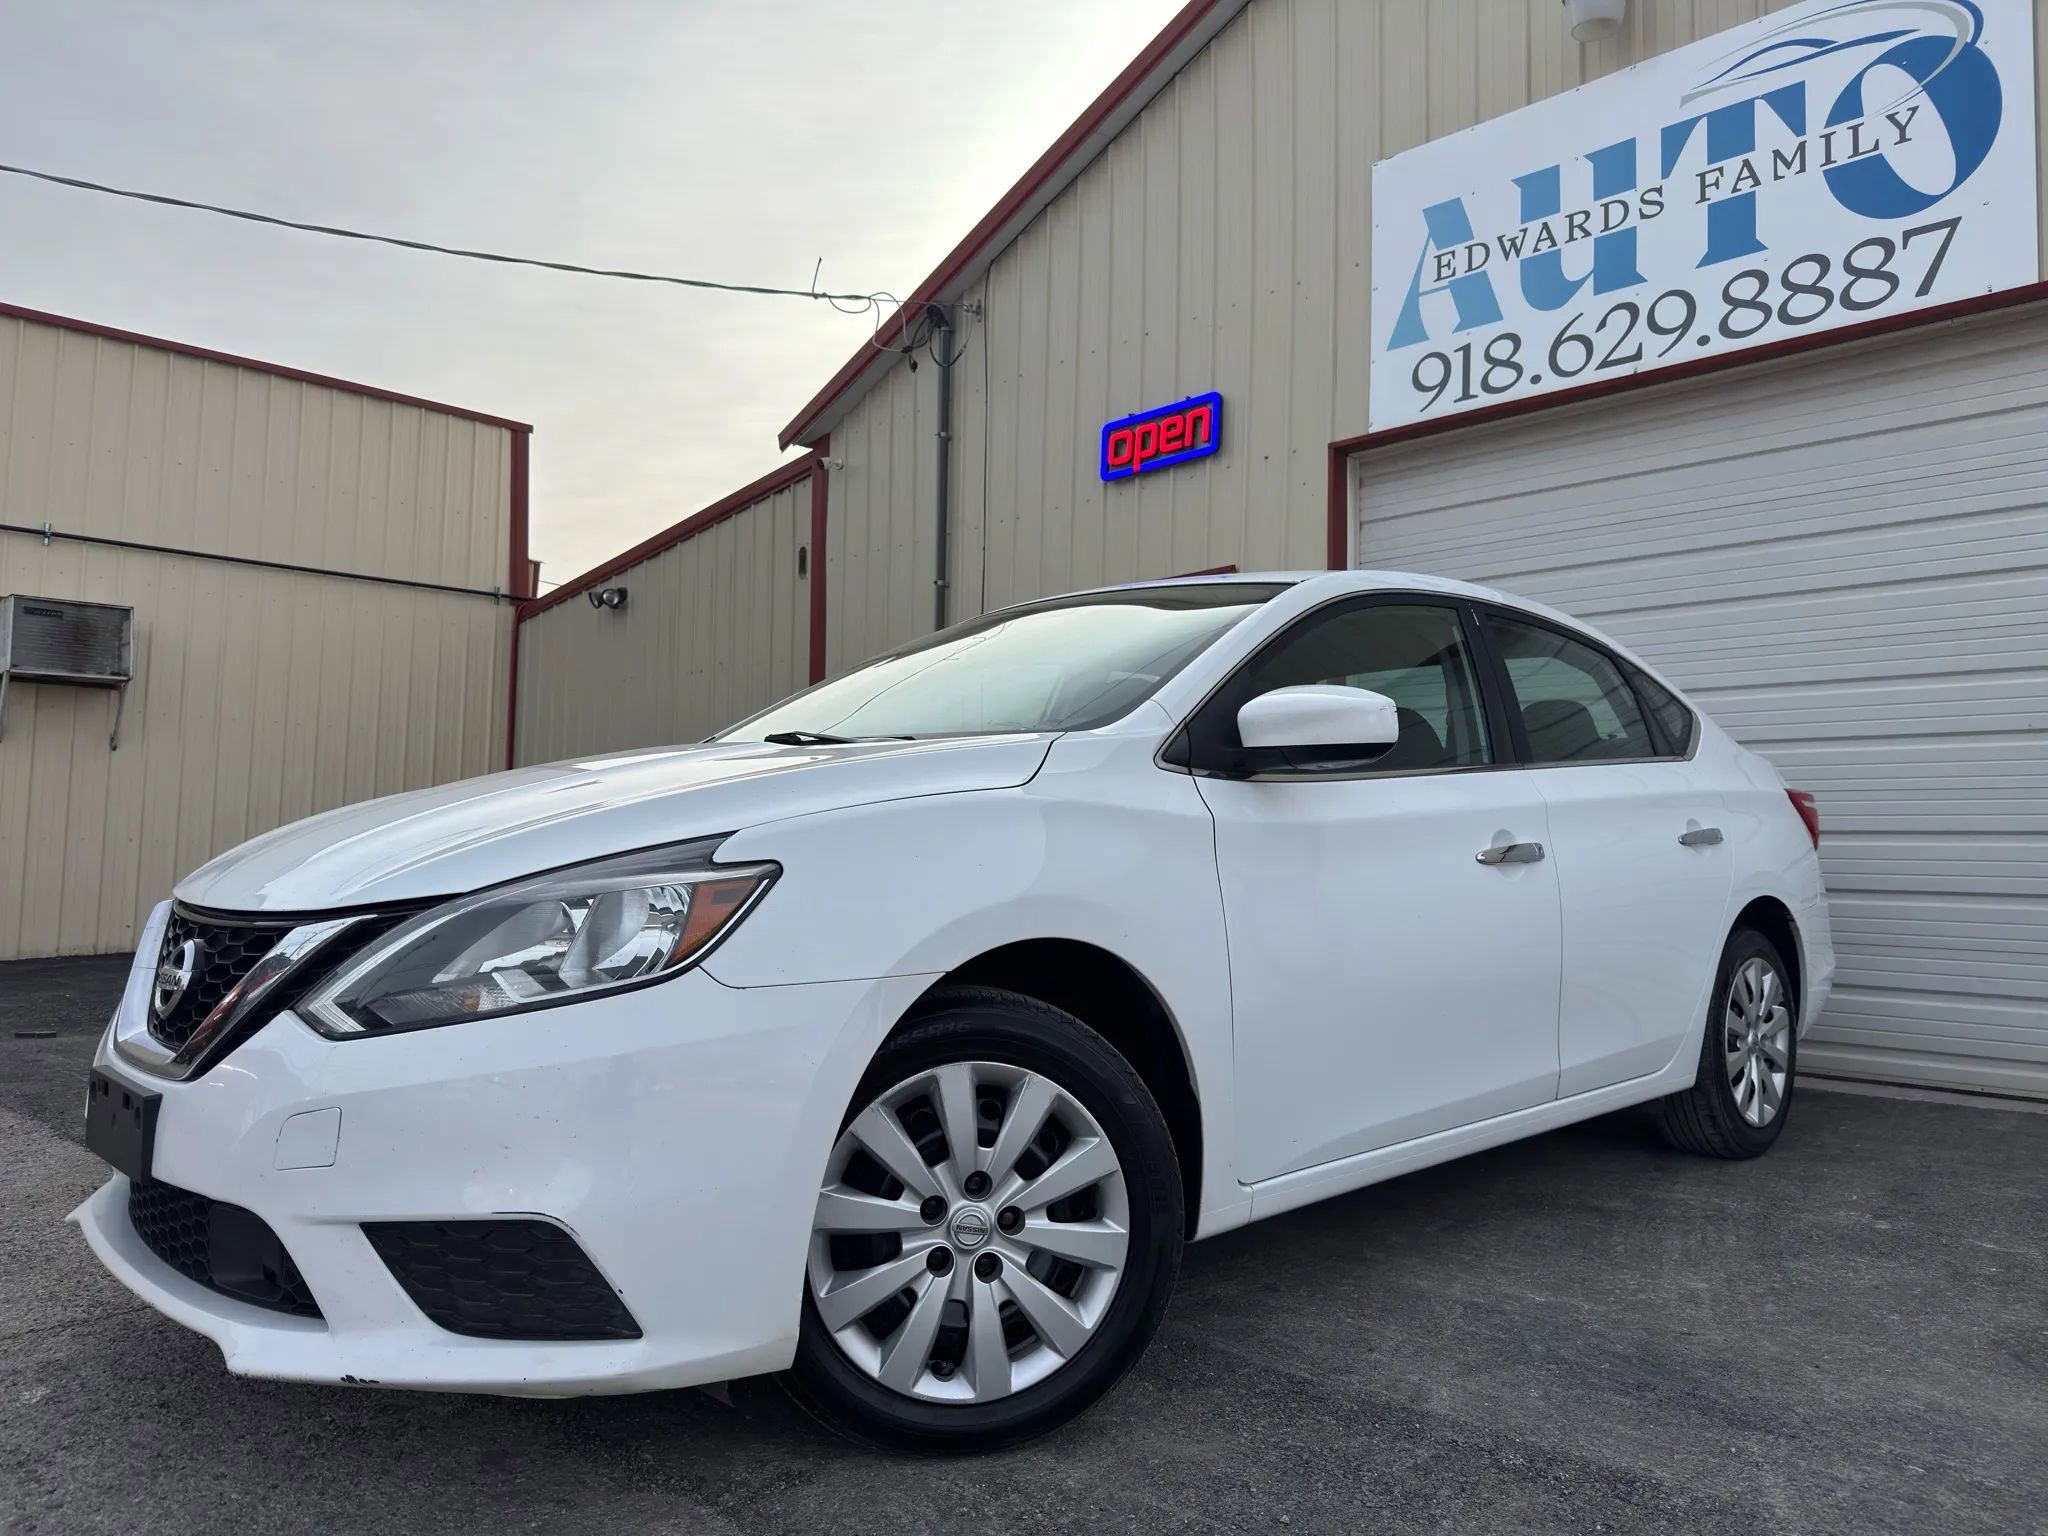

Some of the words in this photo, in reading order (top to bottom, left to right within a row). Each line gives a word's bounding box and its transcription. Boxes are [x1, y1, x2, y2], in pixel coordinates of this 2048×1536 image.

[1386, 34, 2003, 352] AUTO
[1432, 185, 1665, 283] EDWARDS
[1695, 104, 1921, 206] FAMILY
[1411, 216, 1963, 414] 918.629.8887
[1108, 406, 1212, 473] open
[955, 1224, 985, 1234] NISSAN
